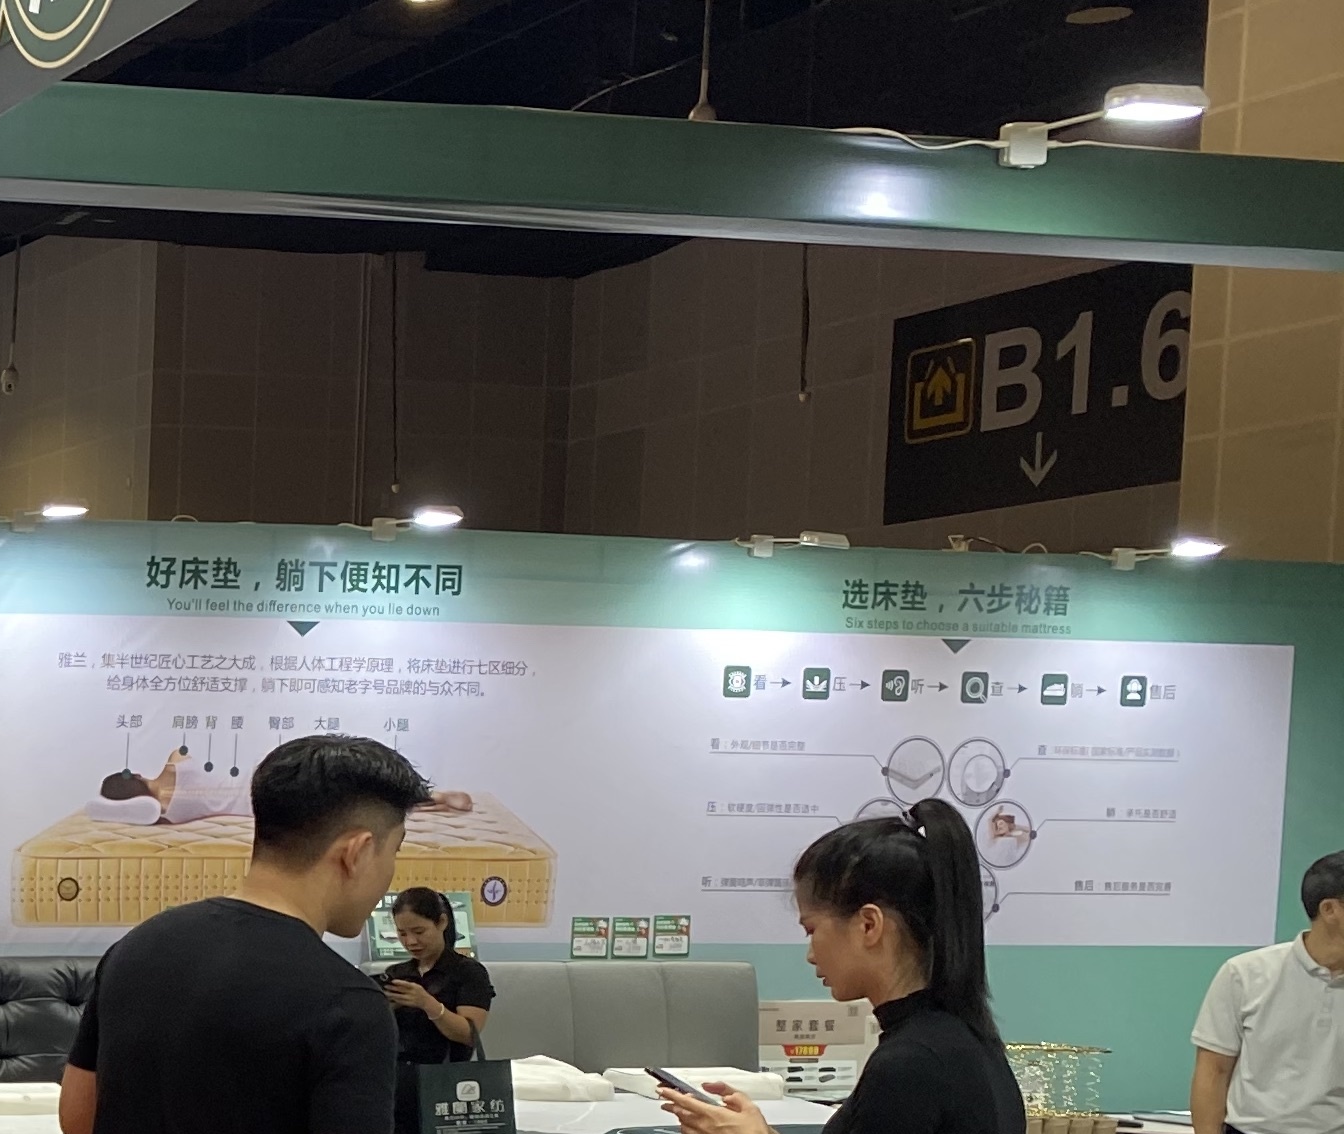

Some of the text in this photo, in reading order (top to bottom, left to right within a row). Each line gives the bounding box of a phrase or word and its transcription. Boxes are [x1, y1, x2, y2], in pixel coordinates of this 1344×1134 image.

[980, 290, 1191, 433] B1.6
[145, 555, 464, 597] 好床垫，躺下便知不同
[842, 578, 1071, 617] 选床垫，六步秘籍
[167, 598, 441, 617] You'll feel the difference when you lie down
[845, 617, 863, 629] Six
[867, 618, 899, 631] steps
[902, 619, 913, 631] to
[916, 619, 959, 632] choose
[972, 621, 1019, 634] suitable
[1021, 622, 1072, 635] mattress
[753, 674, 767, 691] 看
[832, 676, 847, 692] 压
[910, 678, 925, 693] 听
[116, 714, 143, 730] 头部
[172, 714, 199, 730] 肩膀
[314, 716, 341, 731] 大腿
[383, 717, 410, 732] 小腿
